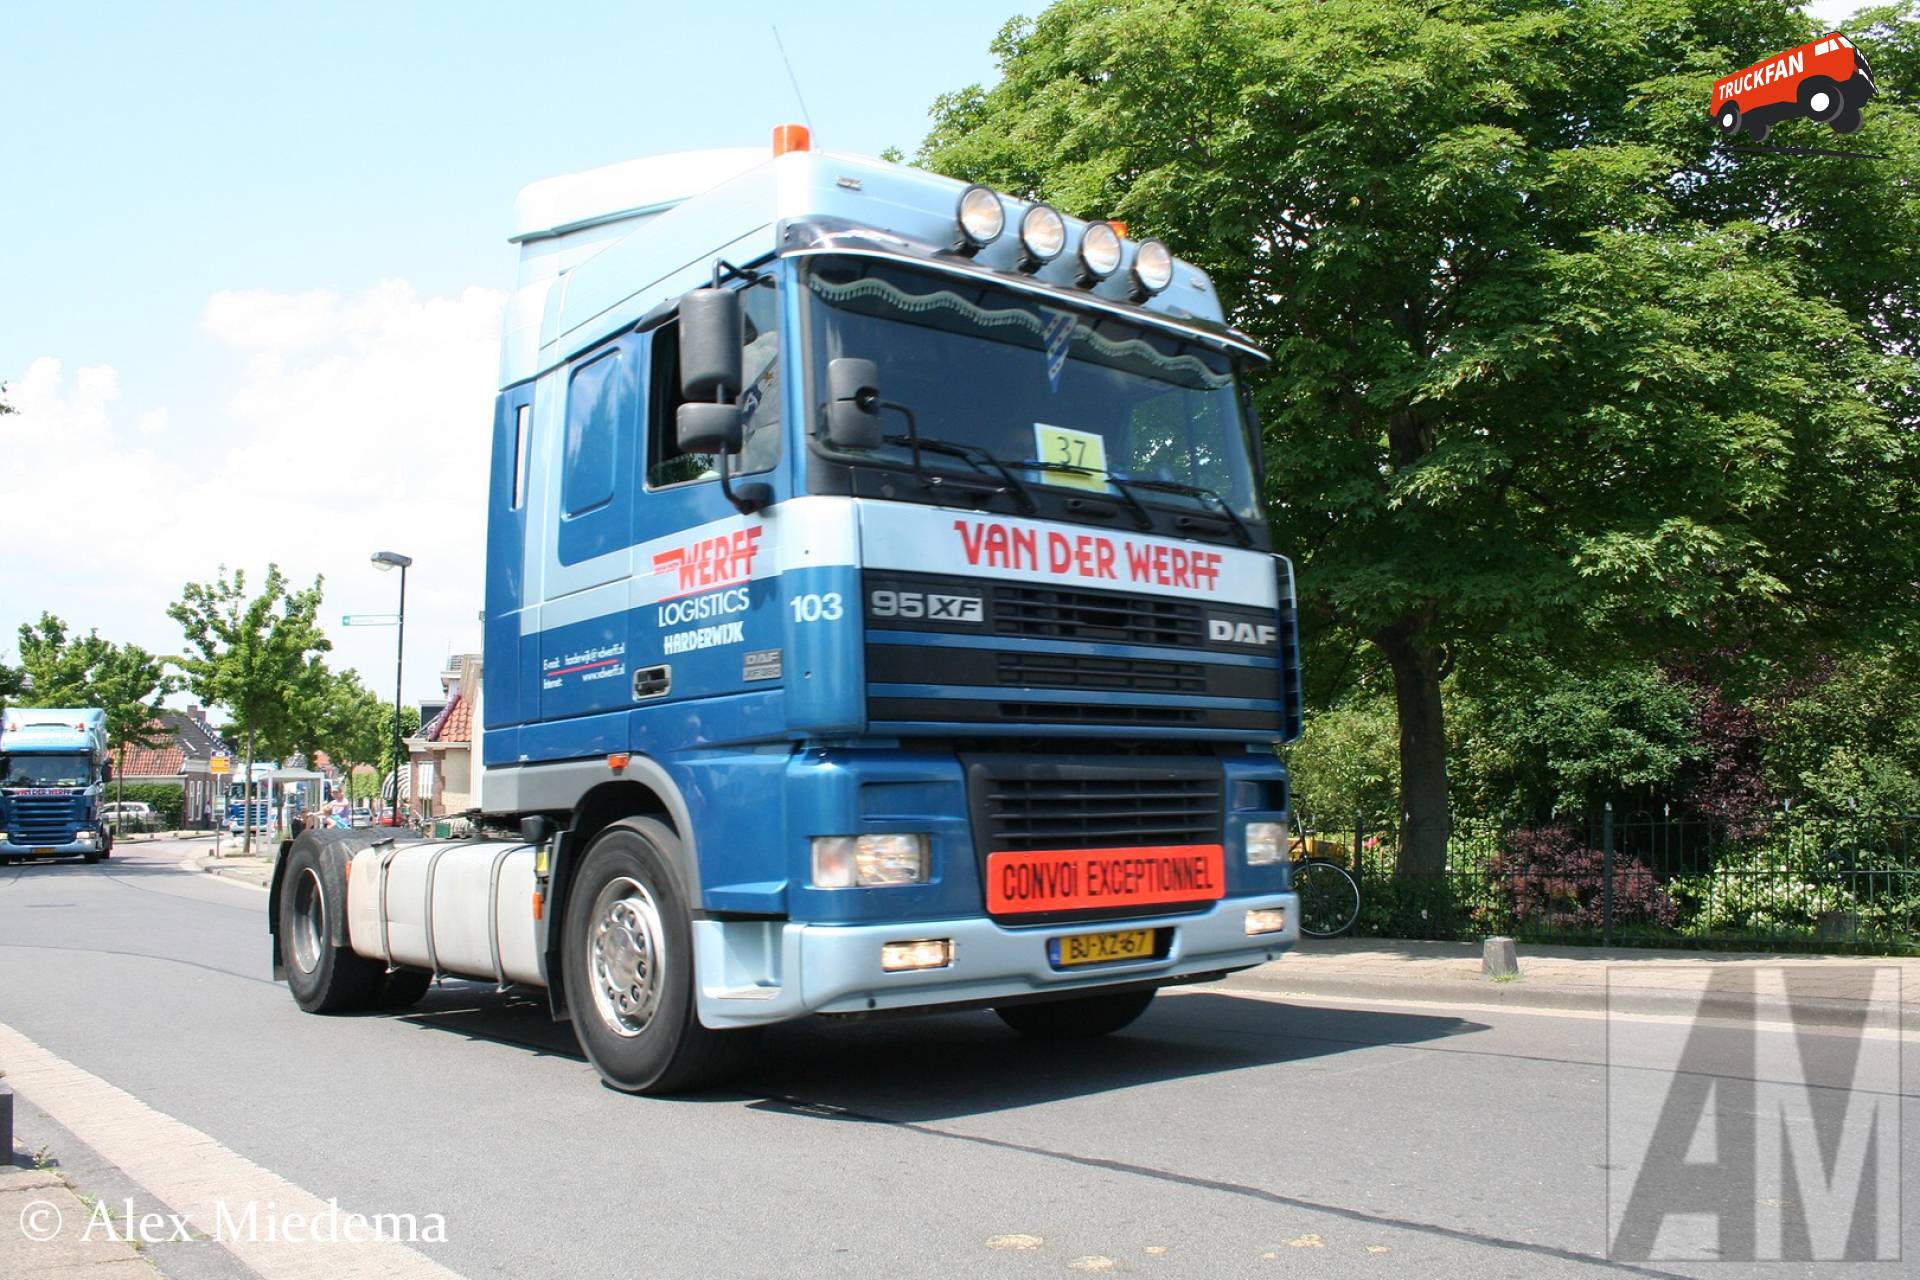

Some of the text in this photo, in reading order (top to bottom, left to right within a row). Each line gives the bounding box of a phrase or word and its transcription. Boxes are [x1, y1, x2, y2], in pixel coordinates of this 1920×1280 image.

[1056, 436, 1086, 467] 37
[653, 525, 762, 590] WERFF
[954, 520, 1222, 591] VAN DER WERFF
[658, 587, 750, 628] LOGISTICS
[790, 592, 844, 623] 103
[664, 621, 745, 656] HARDERWIJK
[1209, 619, 1276, 645] DAF
[1087, 856, 1213, 897] EXCEPTIONNEL
[1070, 931, 1146, 959] BJ-XZ-67
